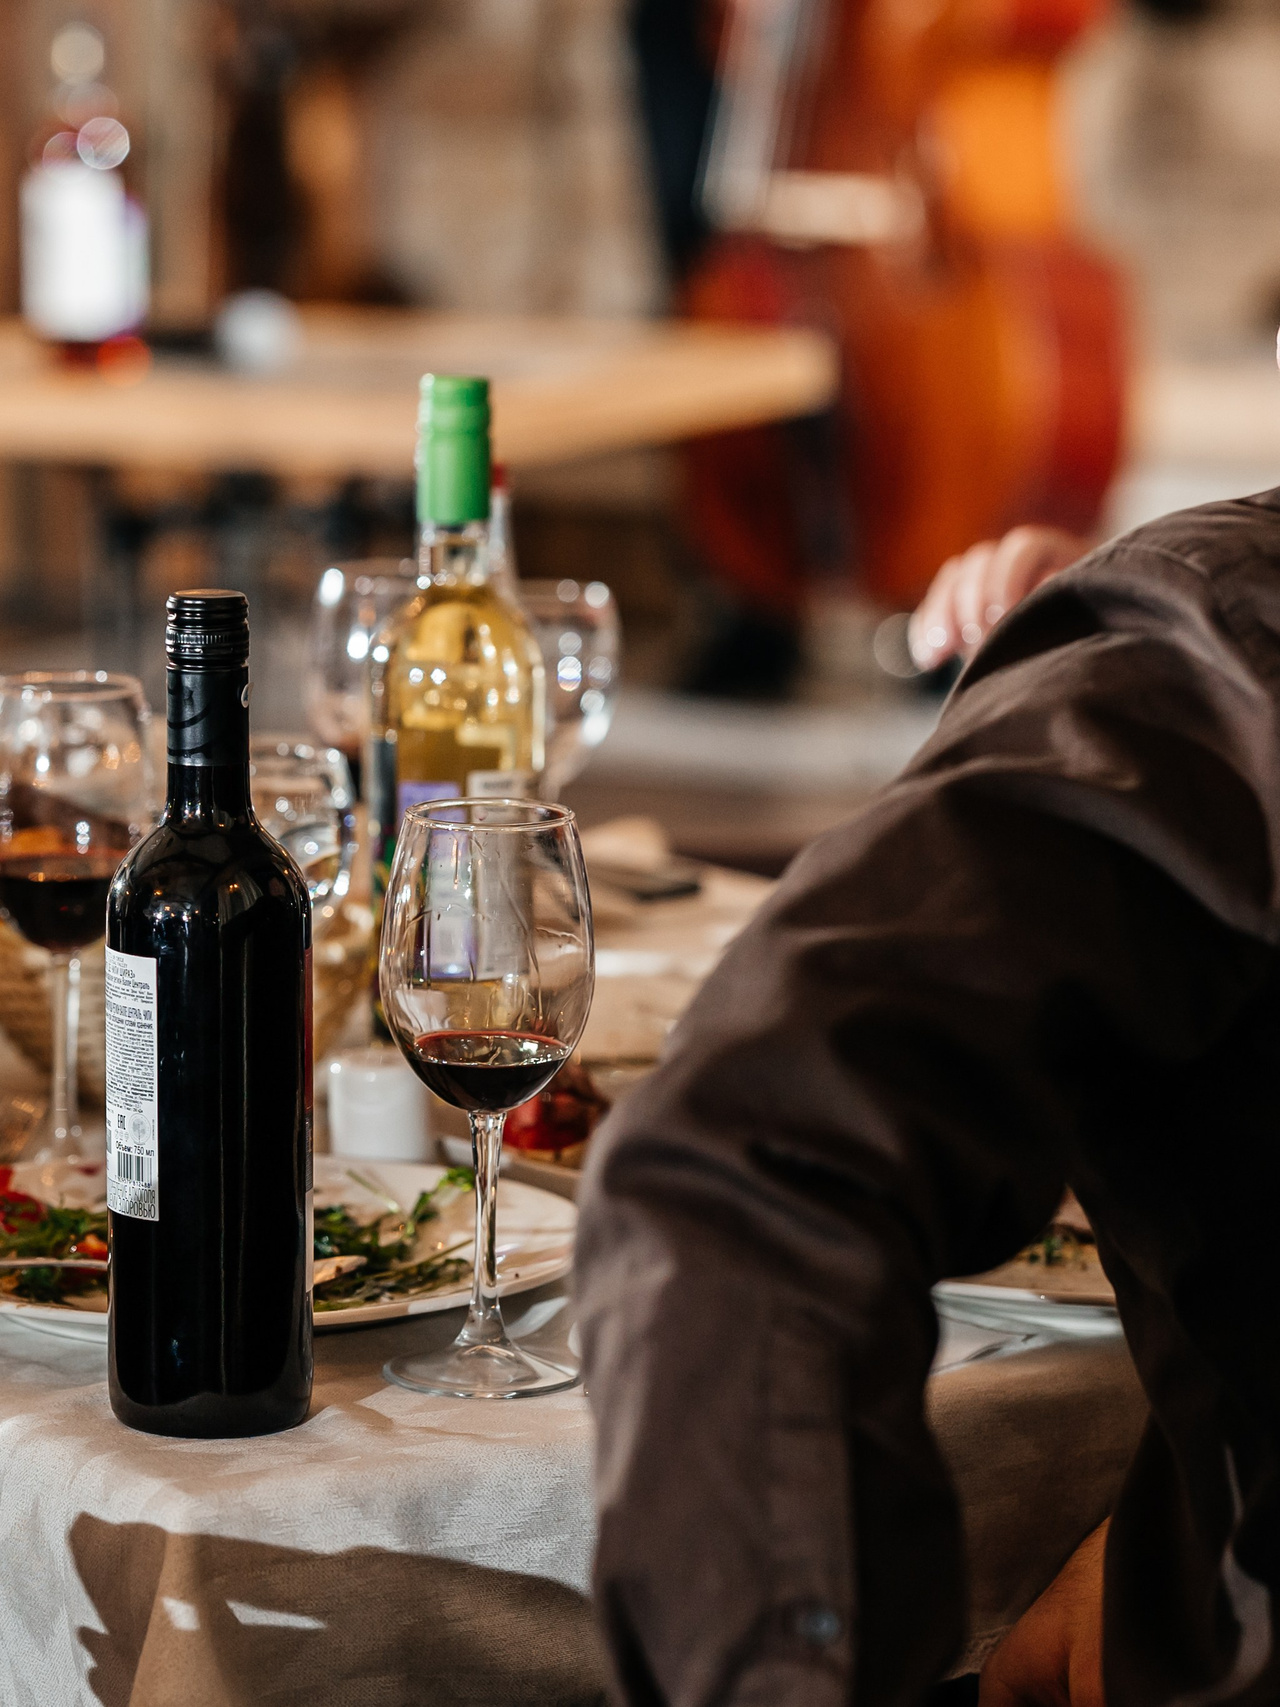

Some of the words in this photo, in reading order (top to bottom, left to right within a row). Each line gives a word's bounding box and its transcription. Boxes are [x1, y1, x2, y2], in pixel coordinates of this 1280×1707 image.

[134, 1145, 144, 1156] 750
[146, 1149, 155, 1157] мл
[118, 1194, 156, 1218] ЗДОРОВЬЮ
